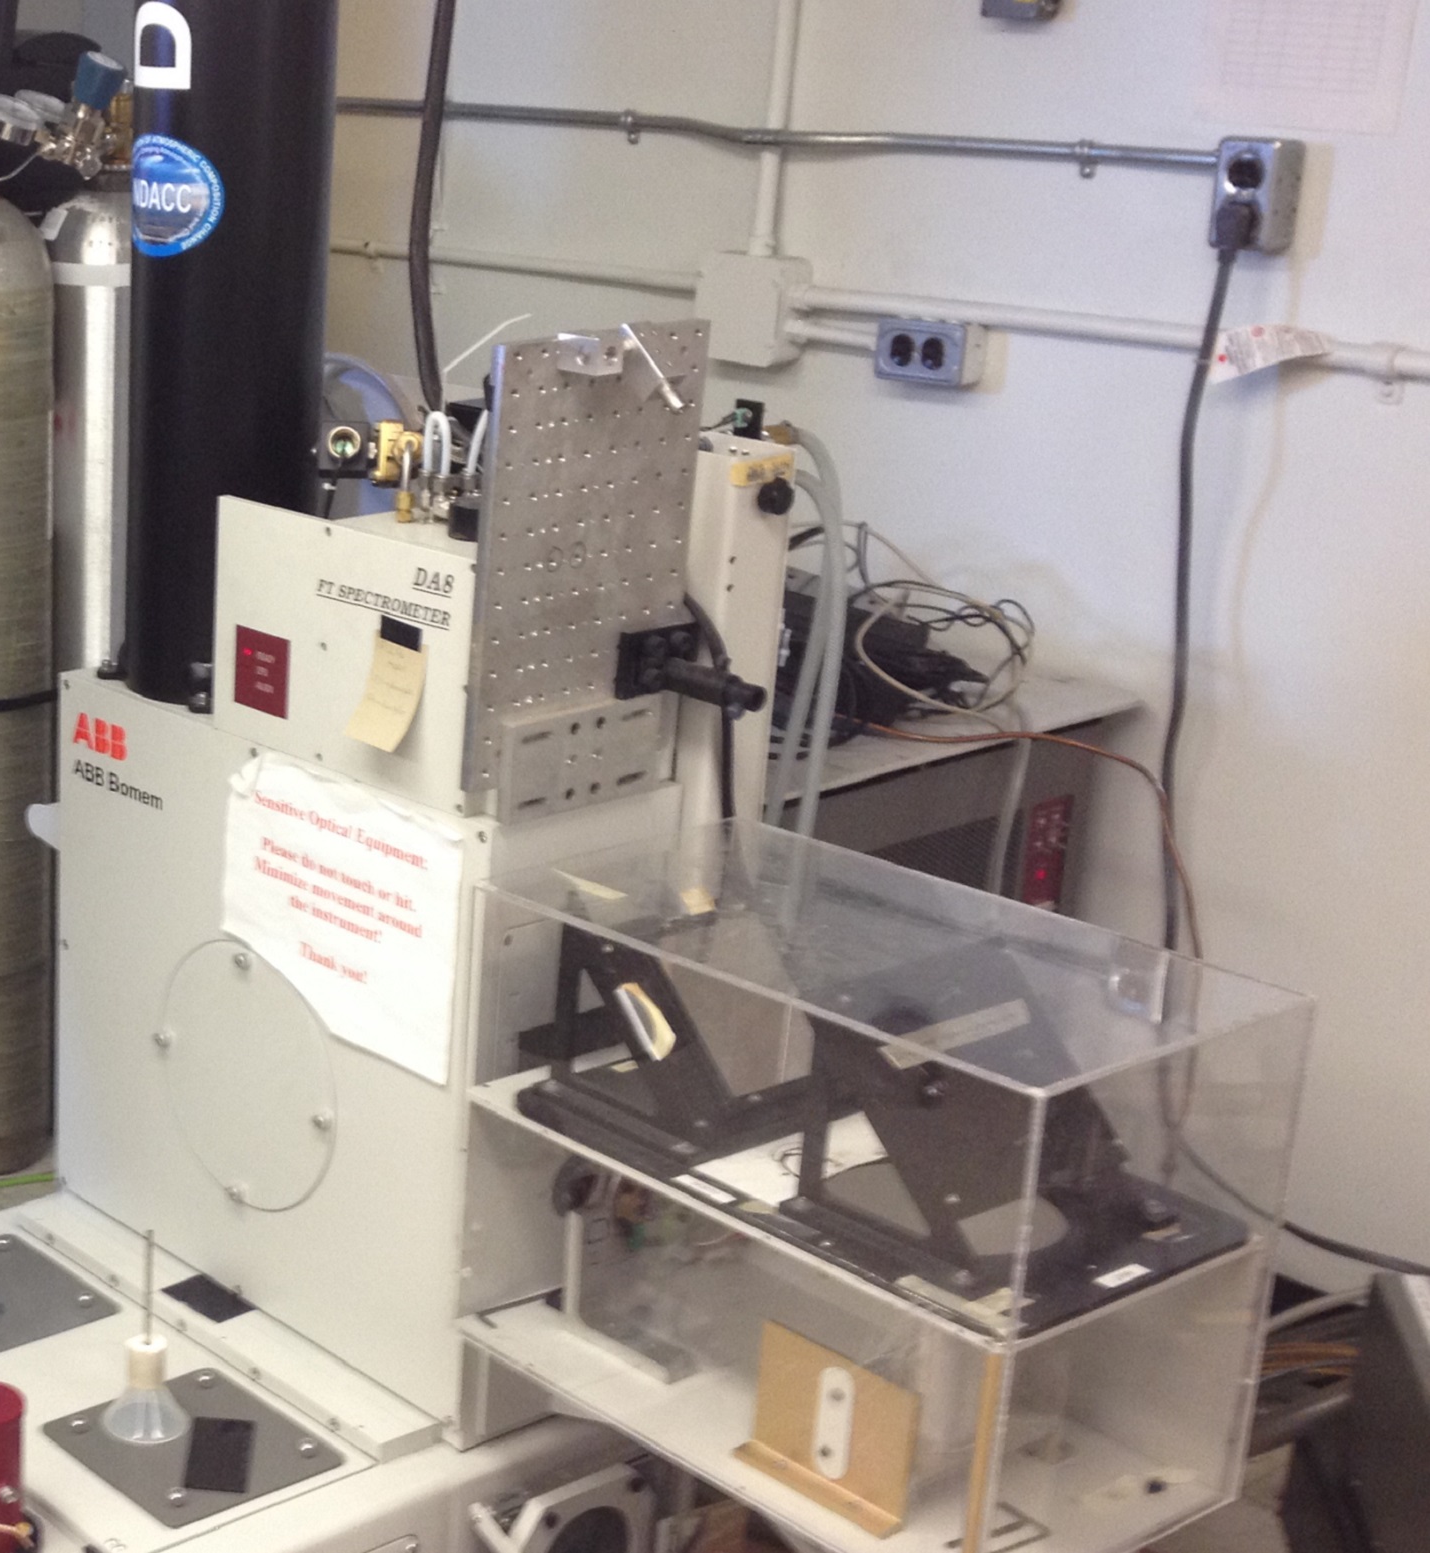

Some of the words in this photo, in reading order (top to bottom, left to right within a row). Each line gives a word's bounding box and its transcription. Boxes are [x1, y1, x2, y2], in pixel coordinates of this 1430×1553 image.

[317, 578, 335, 595] FT
[338, 584, 452, 627] SPECTROMETER
[413, 567, 455, 595] DA8
[73, 712, 127, 761] ABB
[74, 759, 105, 787] ABB
[109, 771, 164, 811] Bomem
[255, 790, 306, 821] Sensitive
[309, 810, 353, 838] Optical
[356, 827, 427, 870] Equipment:
[254, 855, 308, 890] Minimize
[311, 884, 375, 917] movement
[378, 910, 422, 938] around
[261, 836, 298, 862] Please
[301, 853, 316, 870] do
[319, 863, 338, 878] not
[341, 871, 374, 895] touch
[378, 887, 391, 901] or
[395, 891, 416, 912] hit.
[289, 895, 308, 913] the
[311, 902, 383, 944] instrument!
[299, 940, 338, 971] Thank
[340, 965, 368, 985] you!
